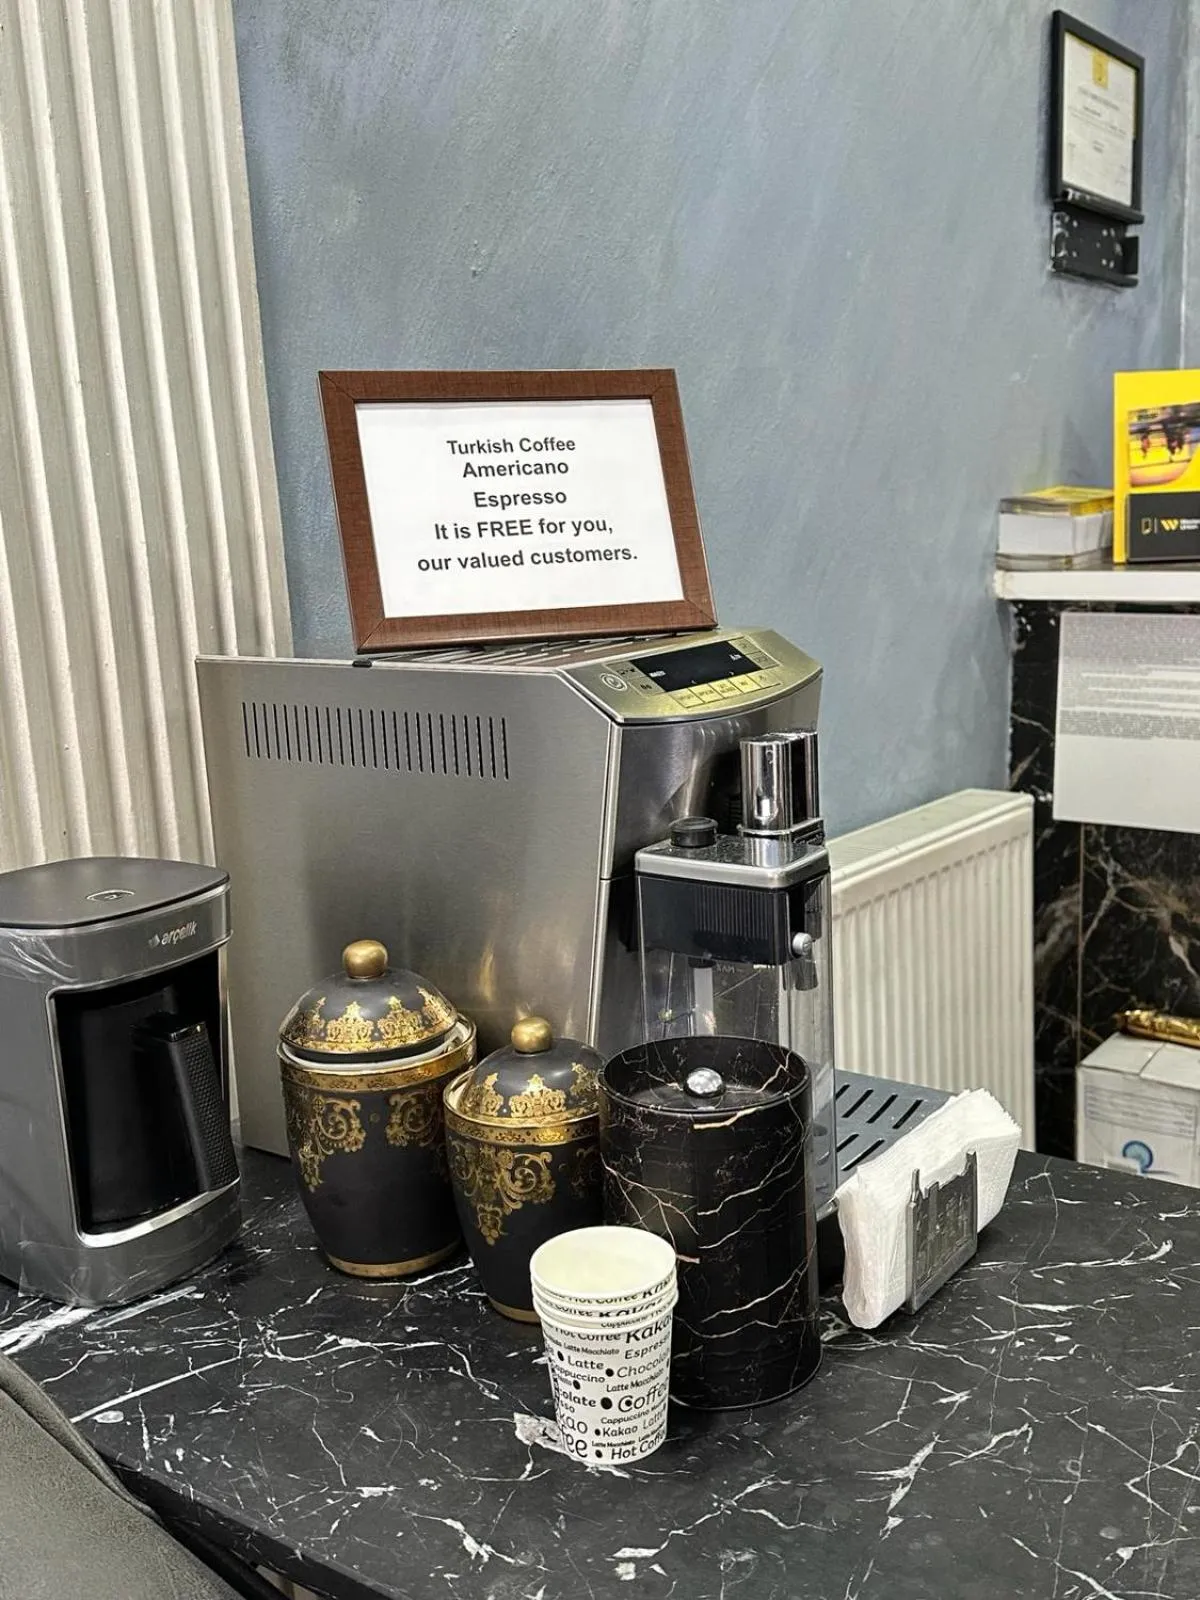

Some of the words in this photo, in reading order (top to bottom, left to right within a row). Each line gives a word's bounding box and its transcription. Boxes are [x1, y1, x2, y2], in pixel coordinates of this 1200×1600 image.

[447, 438, 514, 455] Turkish
[519, 437, 576, 453] Coffee
[463, 460, 569, 478] Americano
[473, 490, 567, 510] Espresso
[435, 523, 449, 540] It
[454, 523, 471, 539] is
[477, 519, 534, 538] FREE
[538, 518, 566, 534] for
[571, 518, 613, 537] you,
[417, 555, 451, 571] our
[457, 550, 525, 570] valued
[530, 547, 638, 566] customers.
[567, 1355, 605, 1370] Latte
[606, 1384, 629, 1393] Latte
[602, 1425, 638, 1438] Kakao
[610, 1445, 637, 1460] Hot
